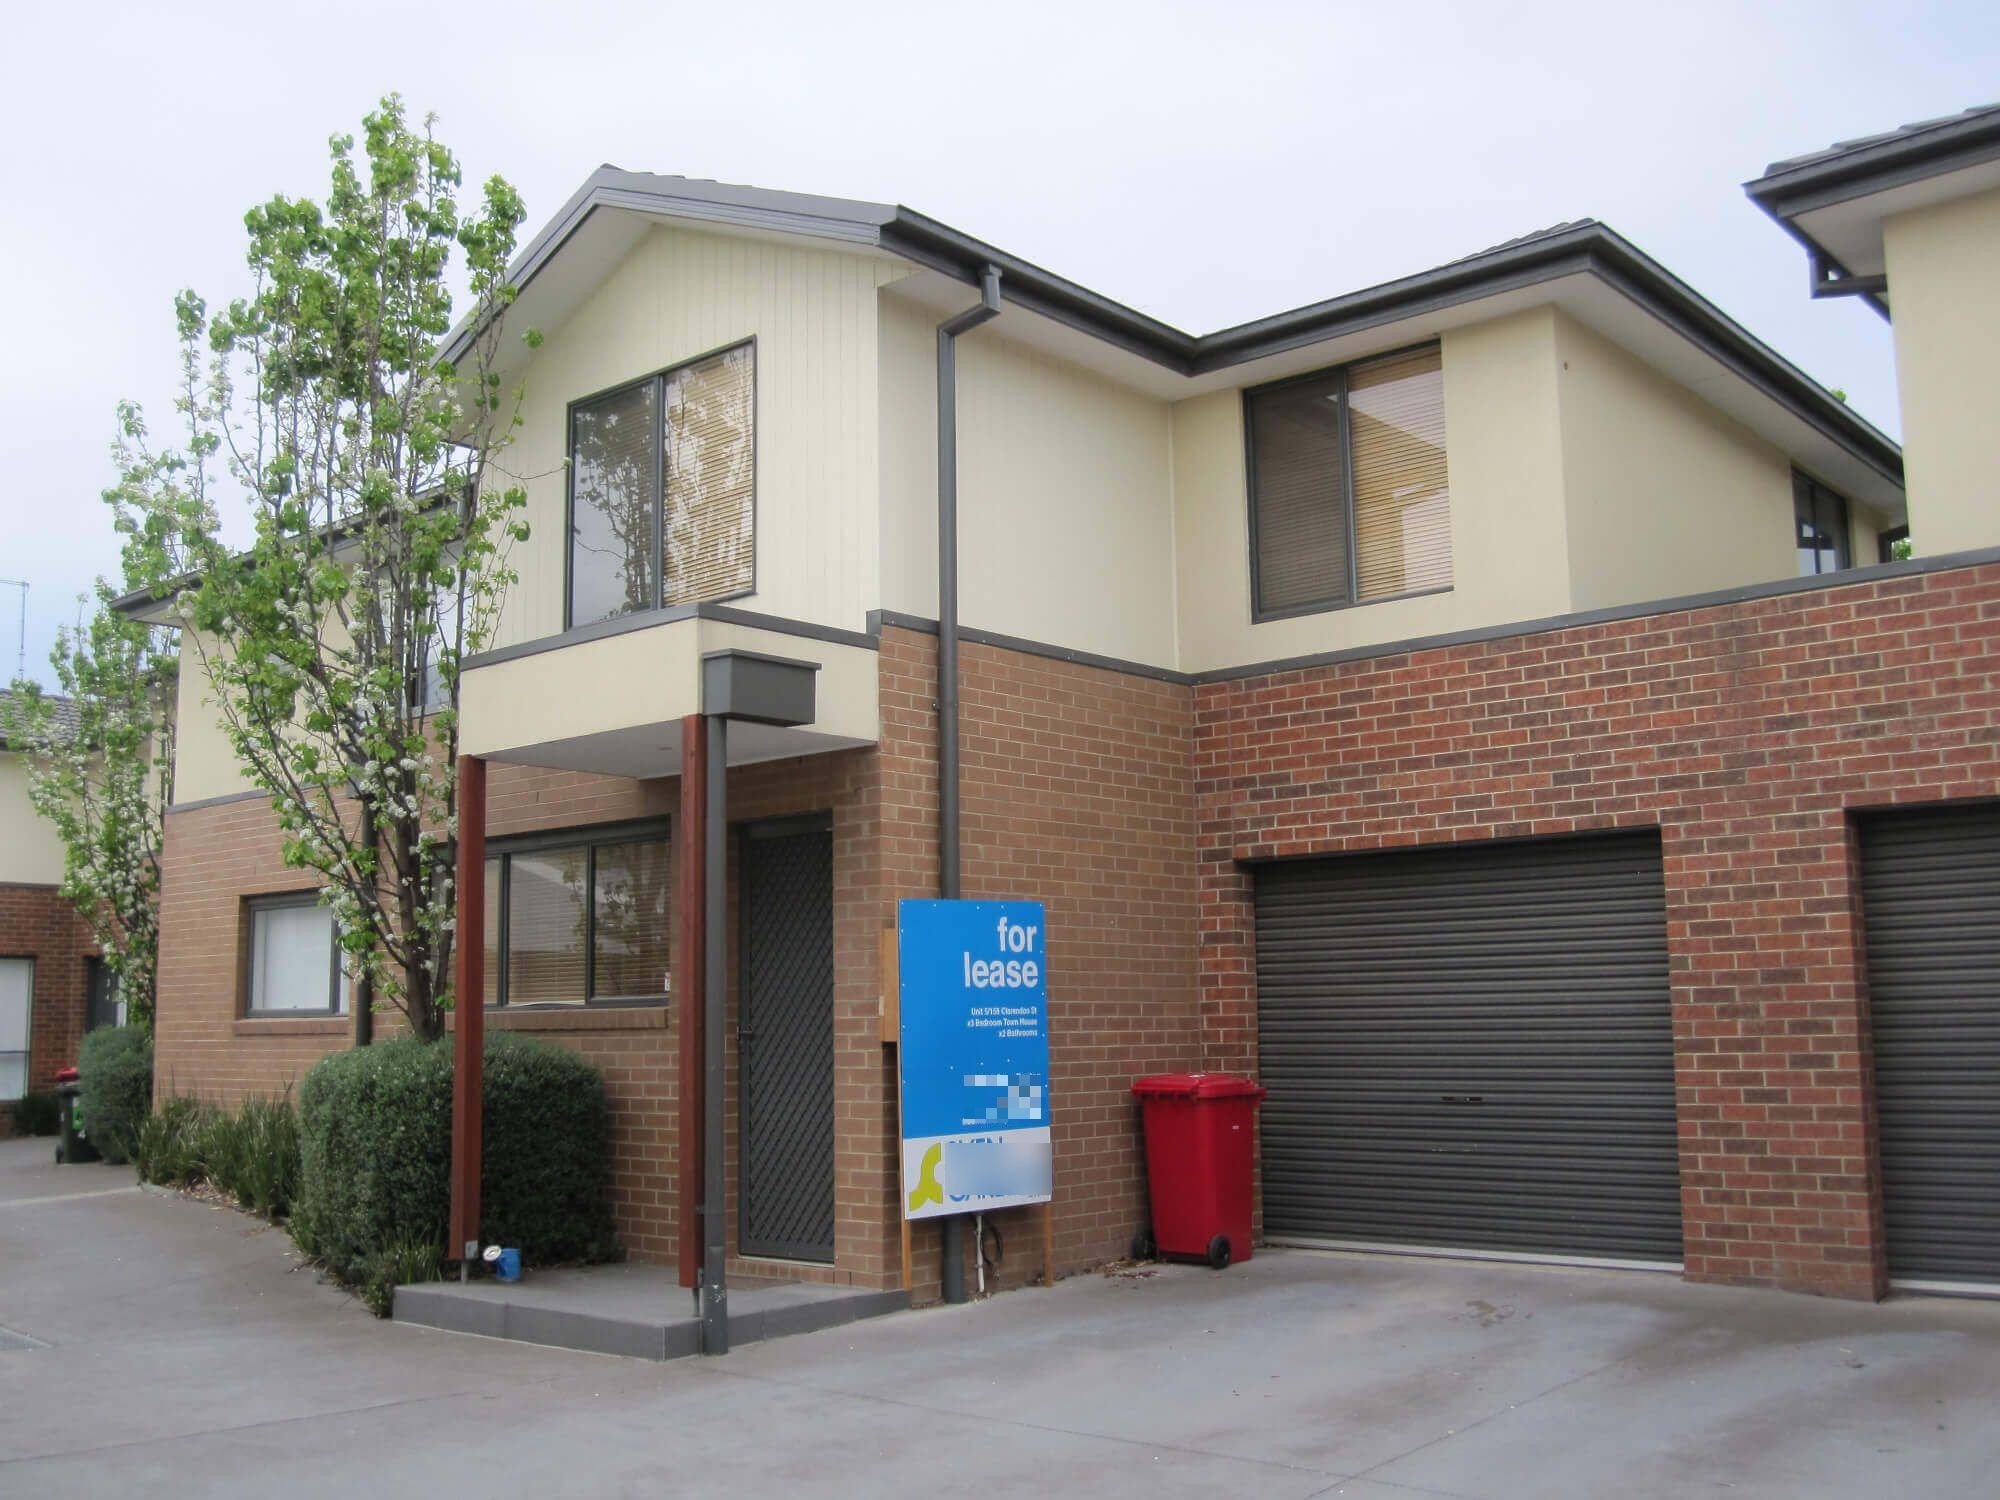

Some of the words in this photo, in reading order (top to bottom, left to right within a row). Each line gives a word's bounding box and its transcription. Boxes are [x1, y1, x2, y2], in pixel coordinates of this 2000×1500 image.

[997, 916, 1037, 952] for
[964, 952, 1038, 988] lease
[971, 1007, 983, 1016] Unit
